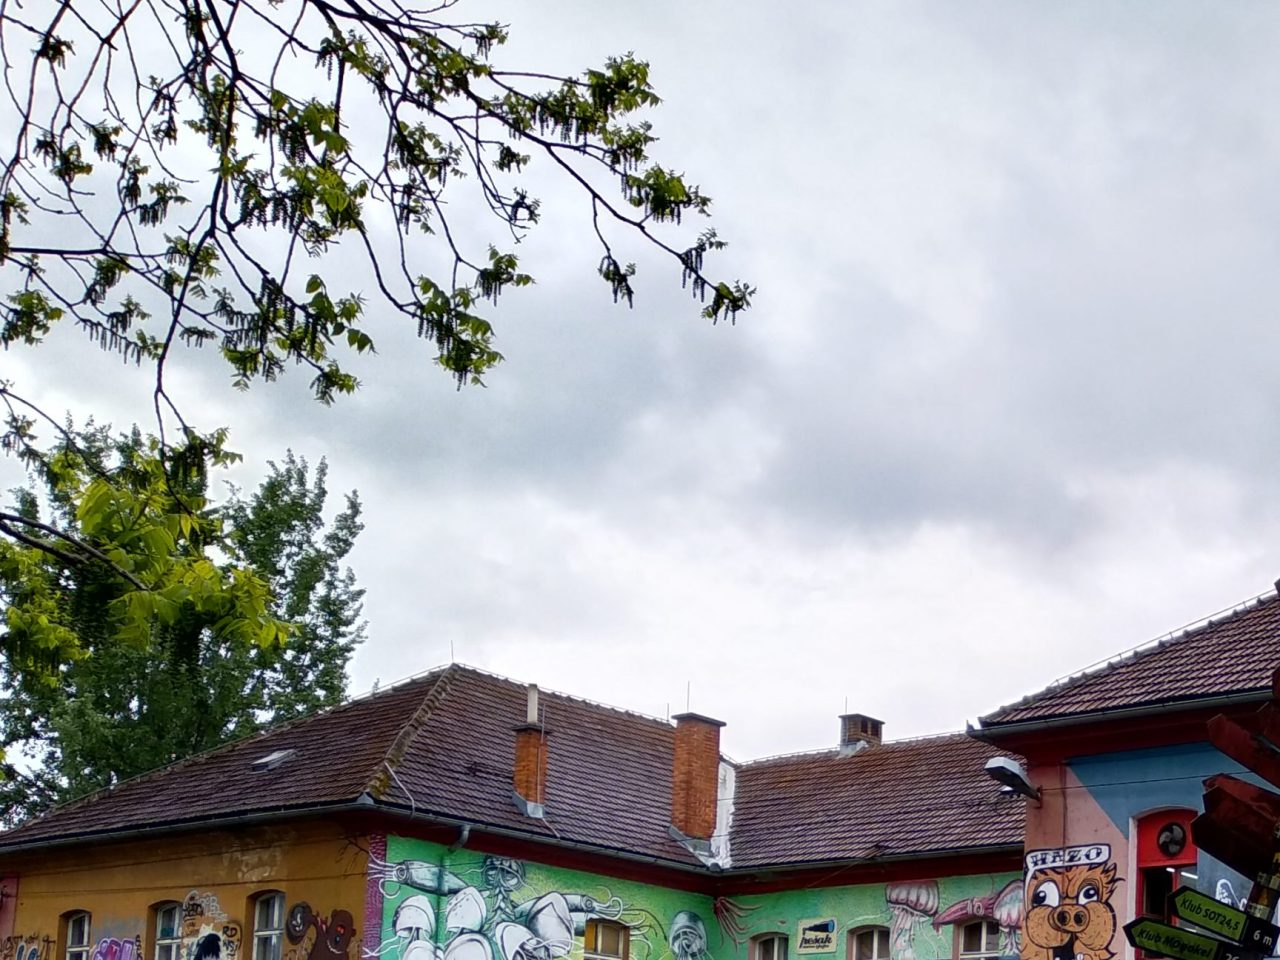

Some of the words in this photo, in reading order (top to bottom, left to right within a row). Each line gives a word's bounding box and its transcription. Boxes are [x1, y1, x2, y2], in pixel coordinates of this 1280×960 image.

[1179, 897, 1202, 915] Klub
[1202, 907, 1241, 932] SOT24,5
[1253, 930, 1260, 940] 6
[1137, 928, 1162, 943] Klub
